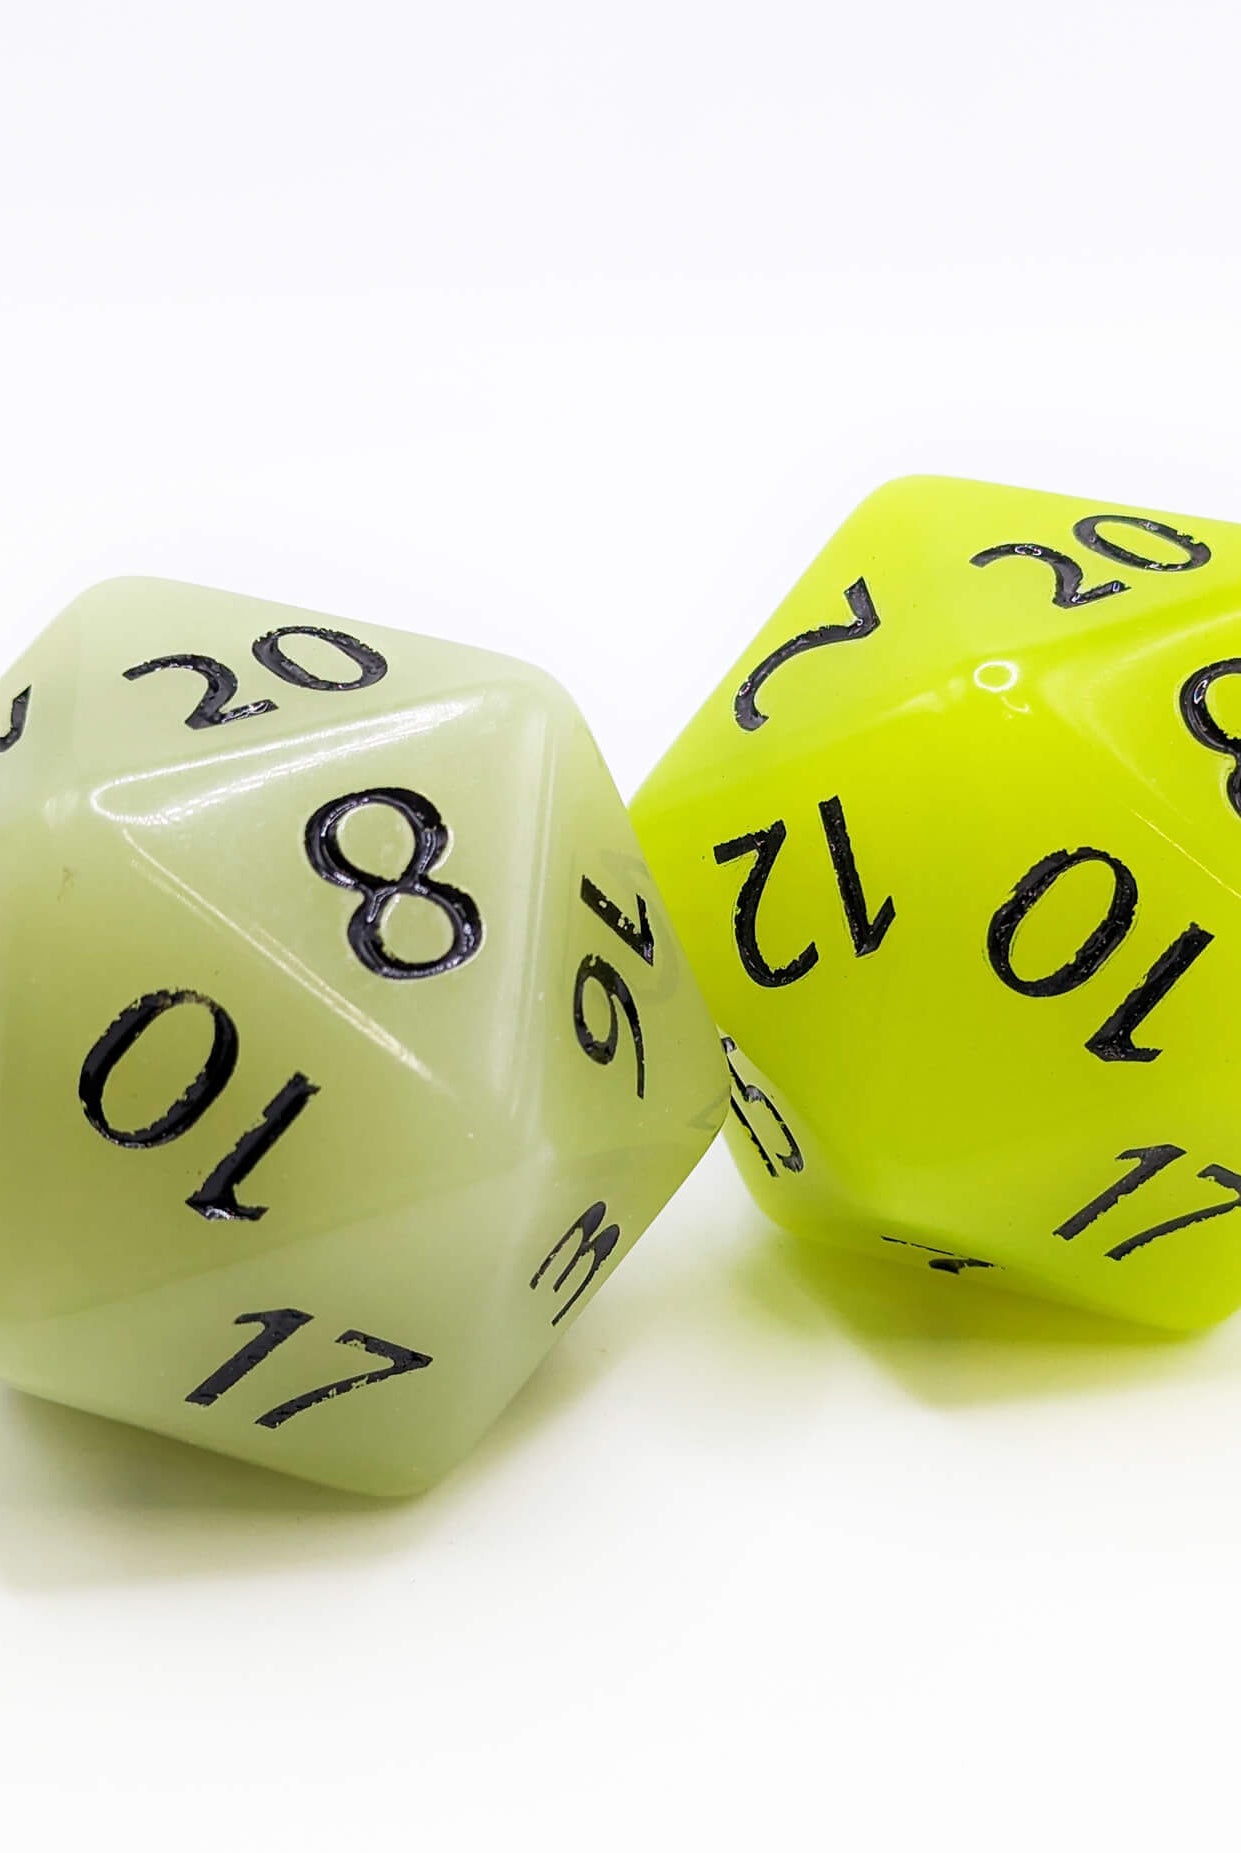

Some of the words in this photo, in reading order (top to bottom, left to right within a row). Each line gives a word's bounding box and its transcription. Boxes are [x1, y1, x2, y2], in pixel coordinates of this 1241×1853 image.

[971, 514, 1212, 609] 20
[123, 626, 388, 730] 20
[304, 787, 484, 980] 8
[713, 796, 897, 987] 12
[986, 846, 1215, 1063] 10
[573, 874, 655, 1100] 16
[78, 988, 321, 1222] 10
[529, 1200, 620, 1327] 3
[185, 1307, 434, 1430] 17
